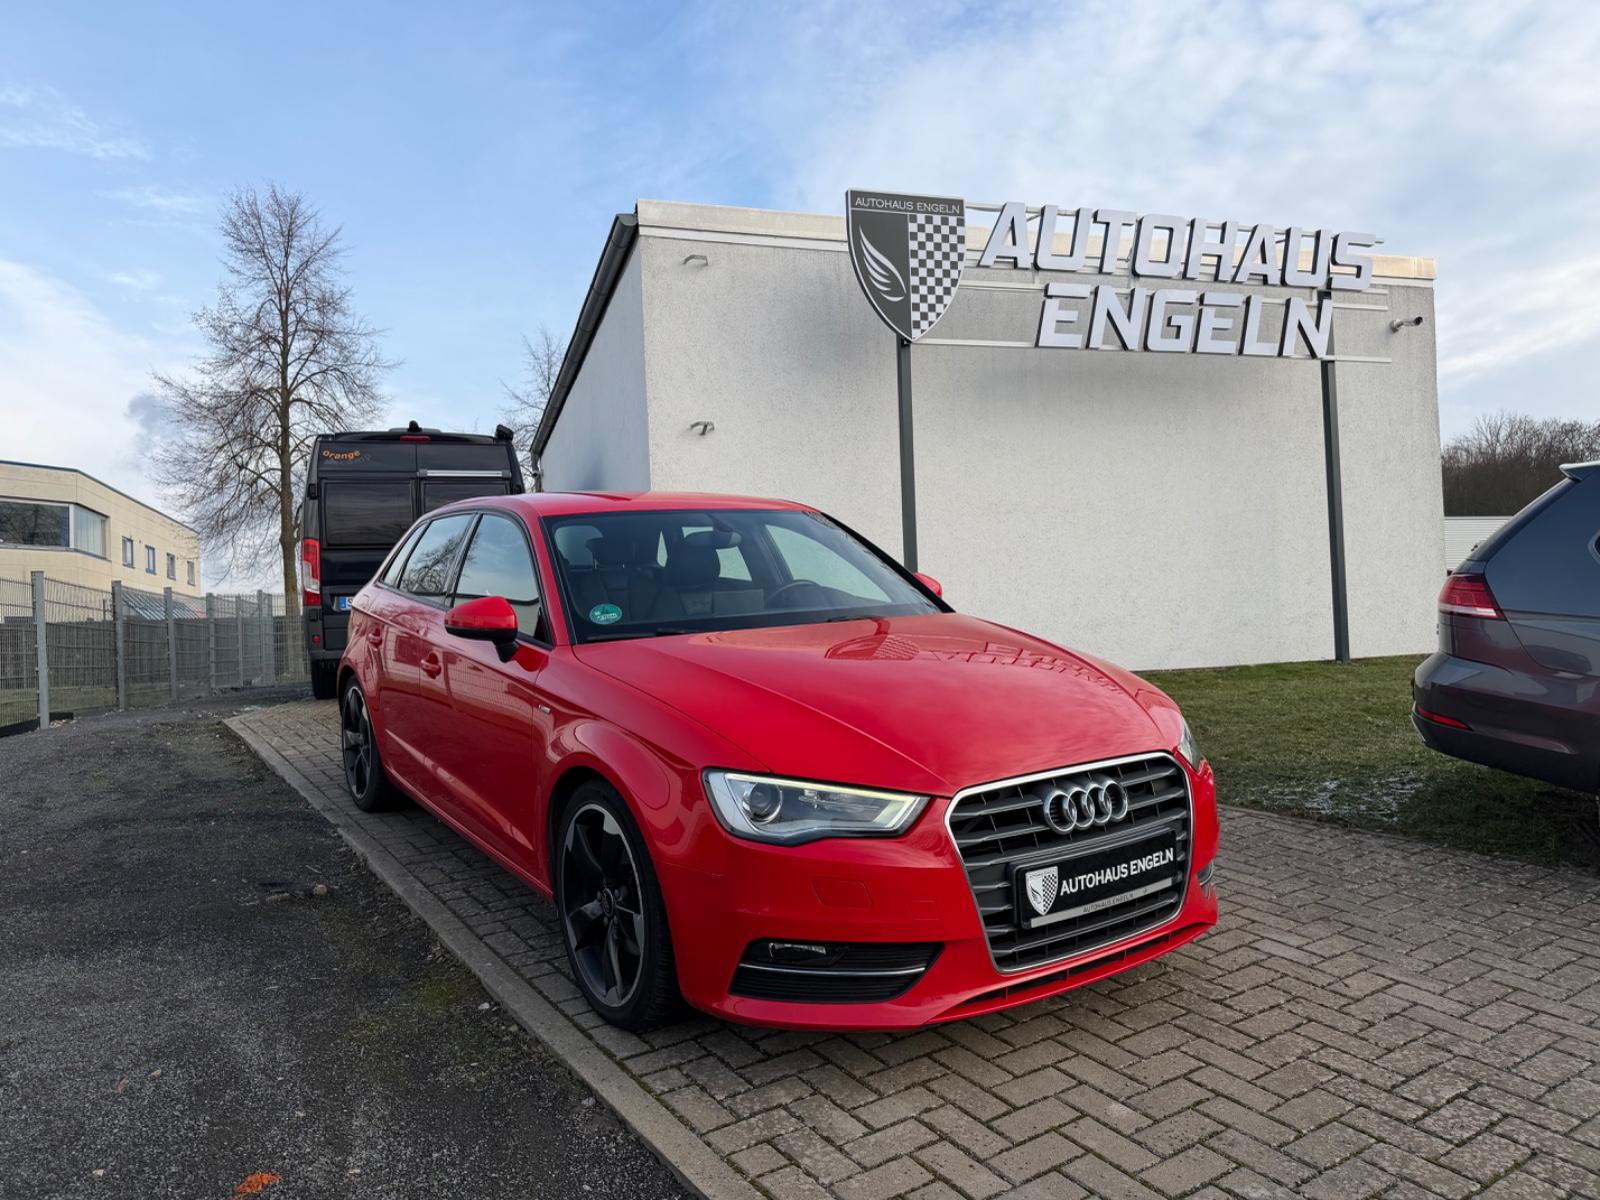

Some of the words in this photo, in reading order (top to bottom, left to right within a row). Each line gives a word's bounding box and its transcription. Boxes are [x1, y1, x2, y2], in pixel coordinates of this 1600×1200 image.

[855, 197, 914, 211] AUTOHAUS
[917, 202, 960, 214] ENGELN
[977, 202, 1376, 290] AUTOHAUS
[1035, 281, 1333, 359] ENGELN
[1060, 864, 1129, 896] AUTOHAUS
[1130, 847, 1174, 875] ENGELN
